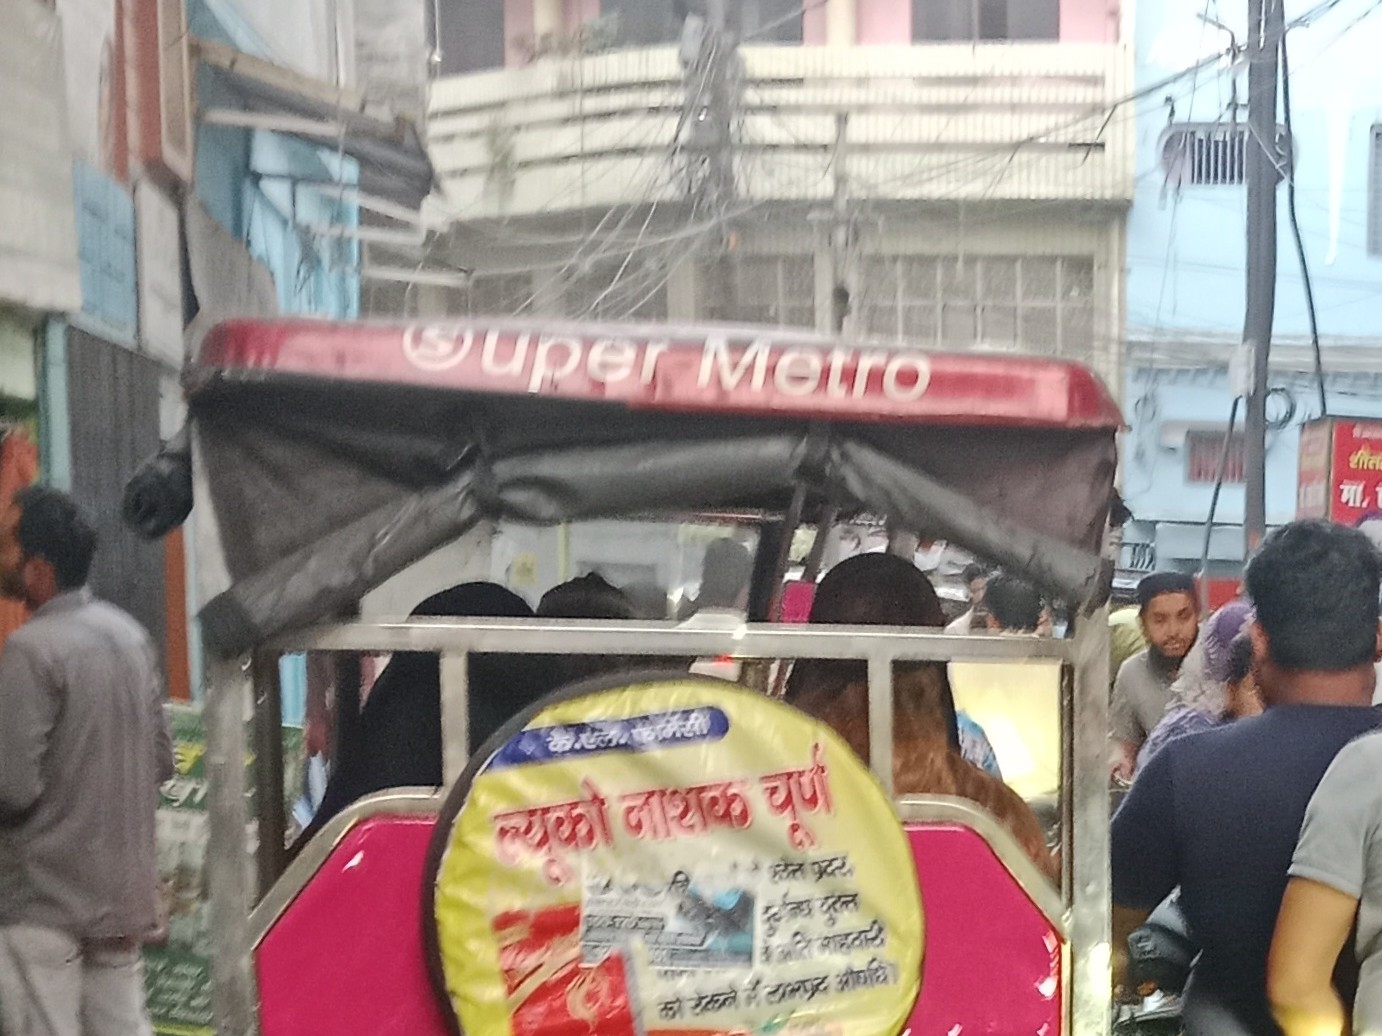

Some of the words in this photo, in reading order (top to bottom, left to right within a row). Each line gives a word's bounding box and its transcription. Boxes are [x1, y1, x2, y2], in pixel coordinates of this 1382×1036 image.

[402, 325, 669, 394] Super
[696, 336, 933, 402] Metro
[618, 778, 754, 842] नाशक
[760, 743, 836, 851] चूर्ण
